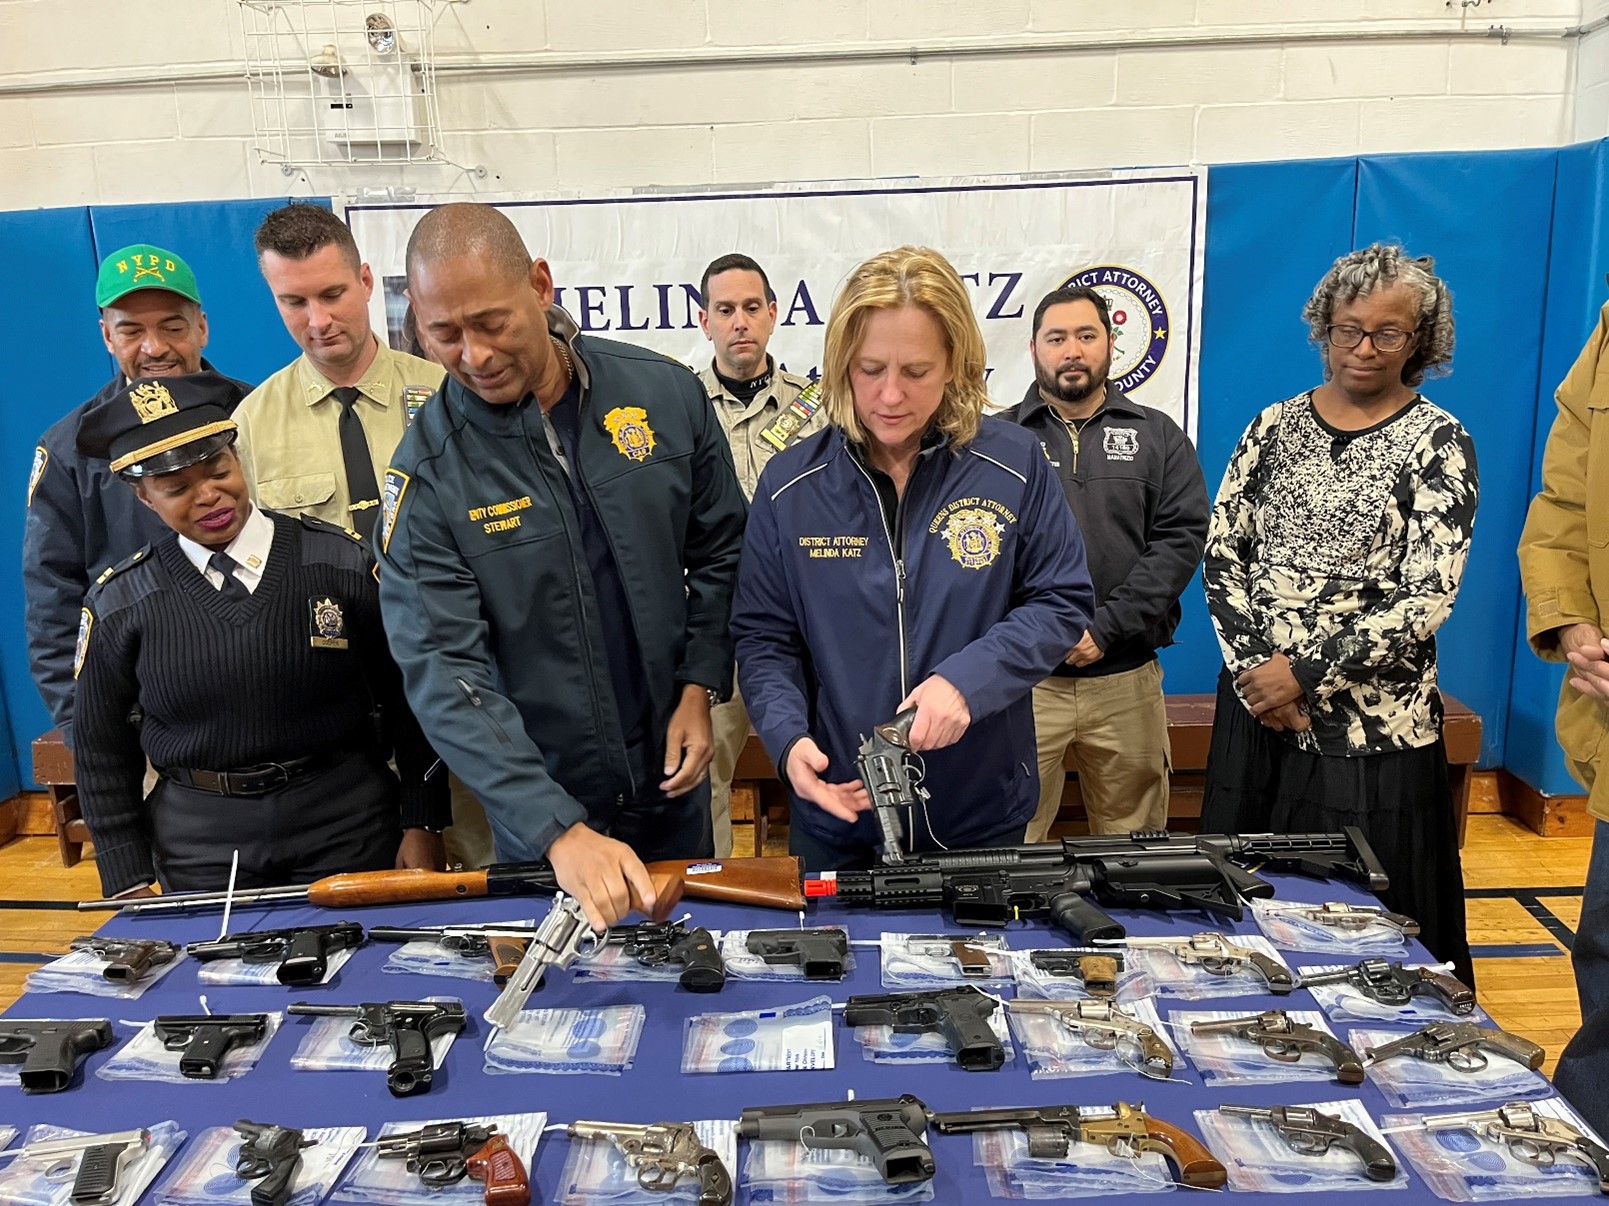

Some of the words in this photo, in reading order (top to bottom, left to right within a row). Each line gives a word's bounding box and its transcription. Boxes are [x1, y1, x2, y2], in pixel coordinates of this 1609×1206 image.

[116, 254, 175, 274] NYPD
[1103, 271, 1163, 315] ATTORNEY
[1114, 355, 1156, 391] OUNTY
[483, 515, 522, 534] STEWART
[928, 508, 949, 534] QUEENS
[948, 497, 980, 512] DISTRICT
[981, 499, 1018, 524] ATTORNEY
[799, 536, 831, 547] DISTRICT
[833, 536, 869, 547] ATTORNEY
[809, 548, 840, 558] MELINDA
[841, 548, 862, 558] KATZ
